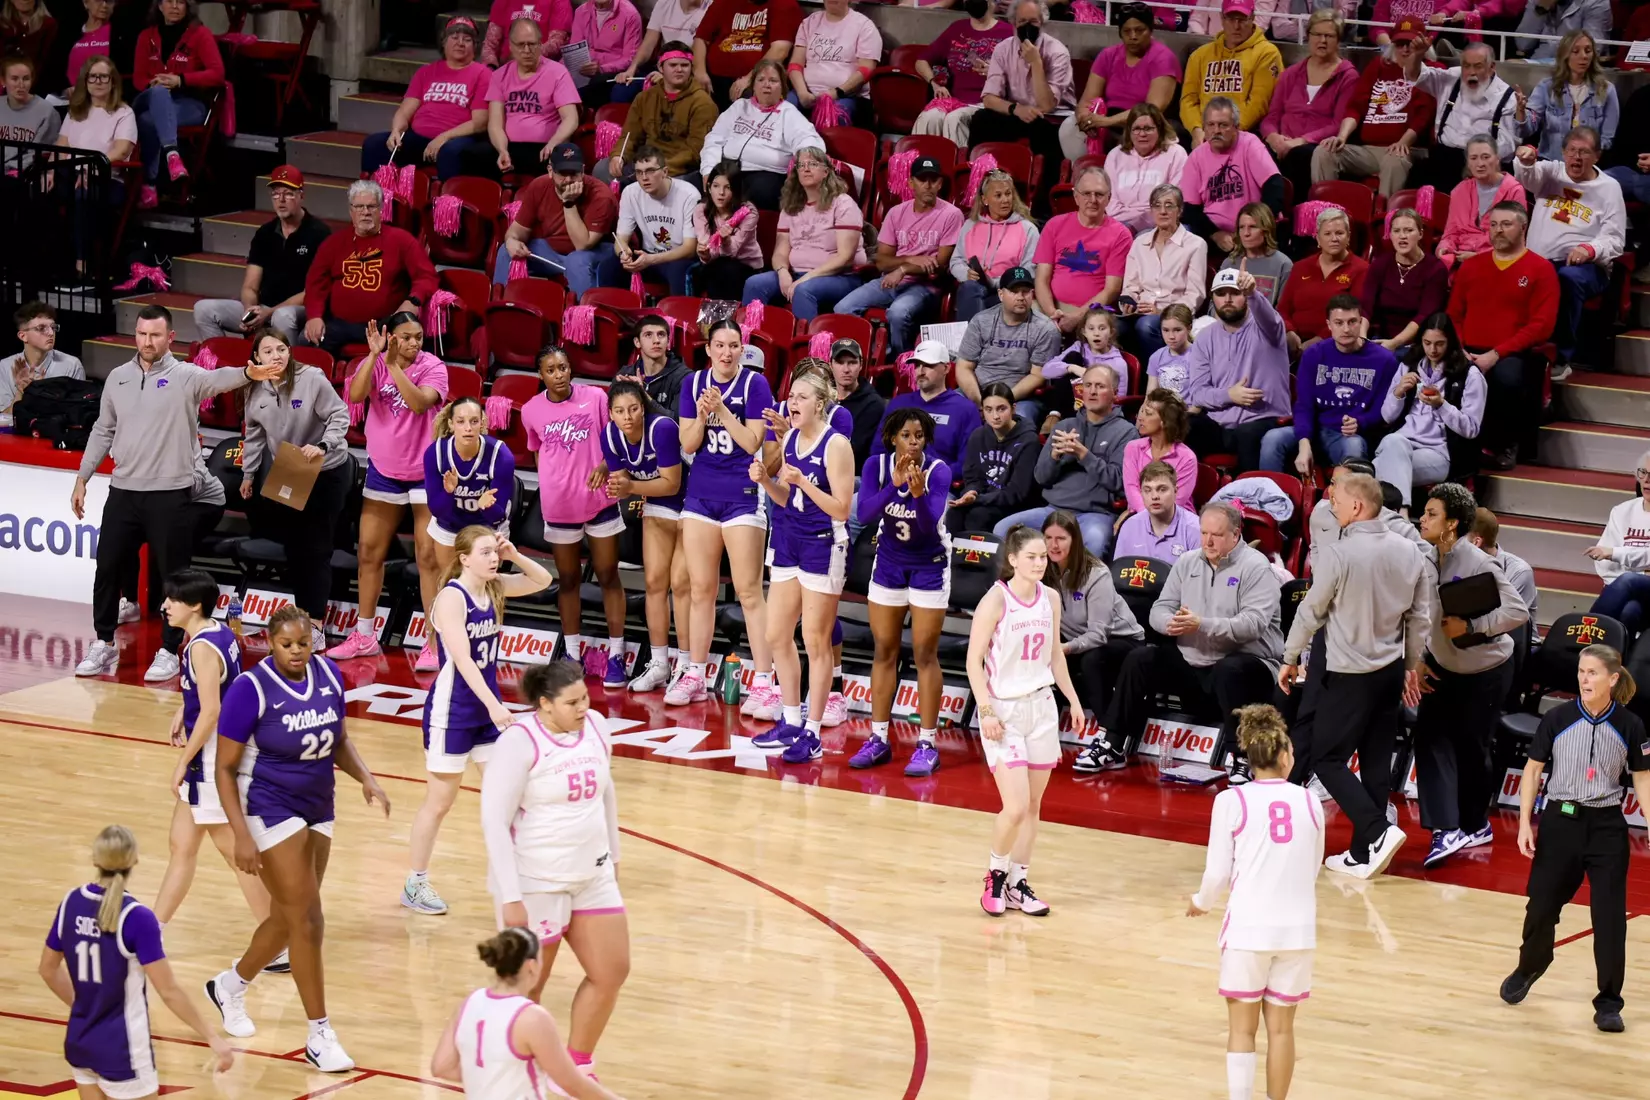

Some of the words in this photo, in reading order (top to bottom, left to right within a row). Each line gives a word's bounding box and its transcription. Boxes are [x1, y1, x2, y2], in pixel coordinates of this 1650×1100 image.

[1206, 60, 1242, 77] IOWA
[427, 82, 468, 95] IOWA
[1203, 77, 1243, 93] STATE
[423, 91, 470, 108] STATE
[659, 215, 676, 225] STATE
[1544, 198, 1593, 224] STATE
[342, 258, 383, 291] 55
[1316, 363, 1376, 391] K-STATE
[571, 428, 590, 442] KAY
[706, 429, 734, 455] 99
[454, 485, 489, 497] ldcat
[454, 497, 479, 512] 10
[884, 501, 917, 519] ildca
[895, 520, 911, 541] 3
[1120, 567, 1157, 584] STATE
[324, 604, 385, 633] HyVe
[1011, 620, 1031, 631] IOWA
[1566, 624, 1607, 642] STATE
[476, 637, 498, 670] 34
[1020, 633, 1045, 661] 12
[282, 705, 339, 733] Wildcats
[299, 728, 335, 761] 22
[1143, 723, 1214, 753] HyVee
[567, 769, 598, 802] 55
[1268, 800, 1294, 843] 8
[75, 915, 101, 938] SIDES
[75, 940, 102, 984] 11
[475, 1019, 486, 1069] 1
